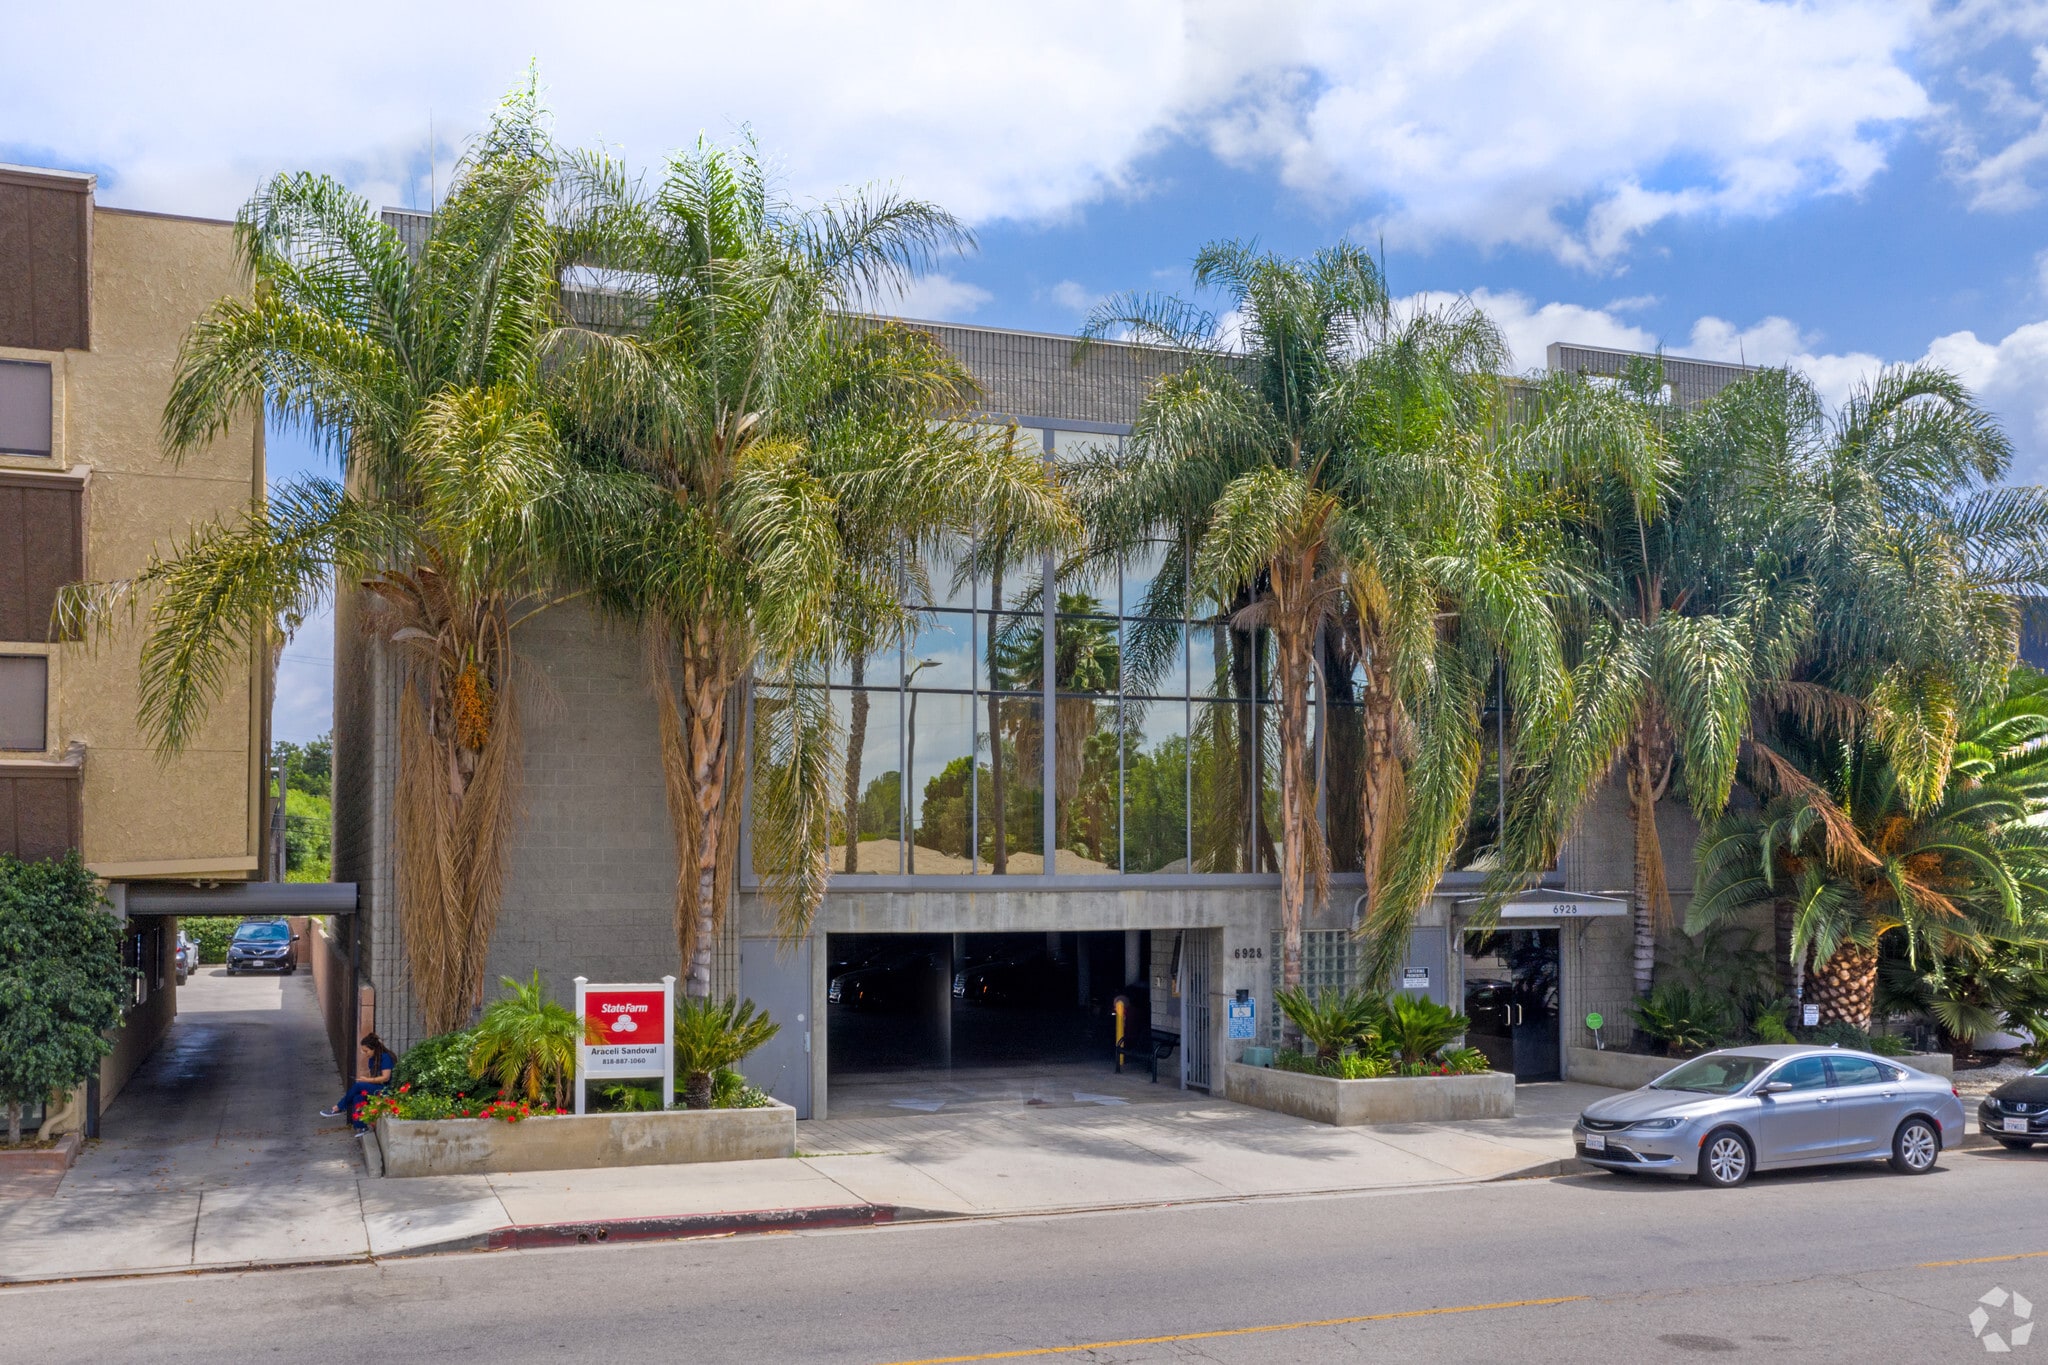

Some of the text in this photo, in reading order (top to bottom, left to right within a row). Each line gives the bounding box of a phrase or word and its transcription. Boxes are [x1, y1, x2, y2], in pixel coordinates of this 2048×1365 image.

[1553, 904, 1577, 914] 6928
[1234, 947, 1262, 959] 6928
[621, 1047, 657, 1055] Sandoval
